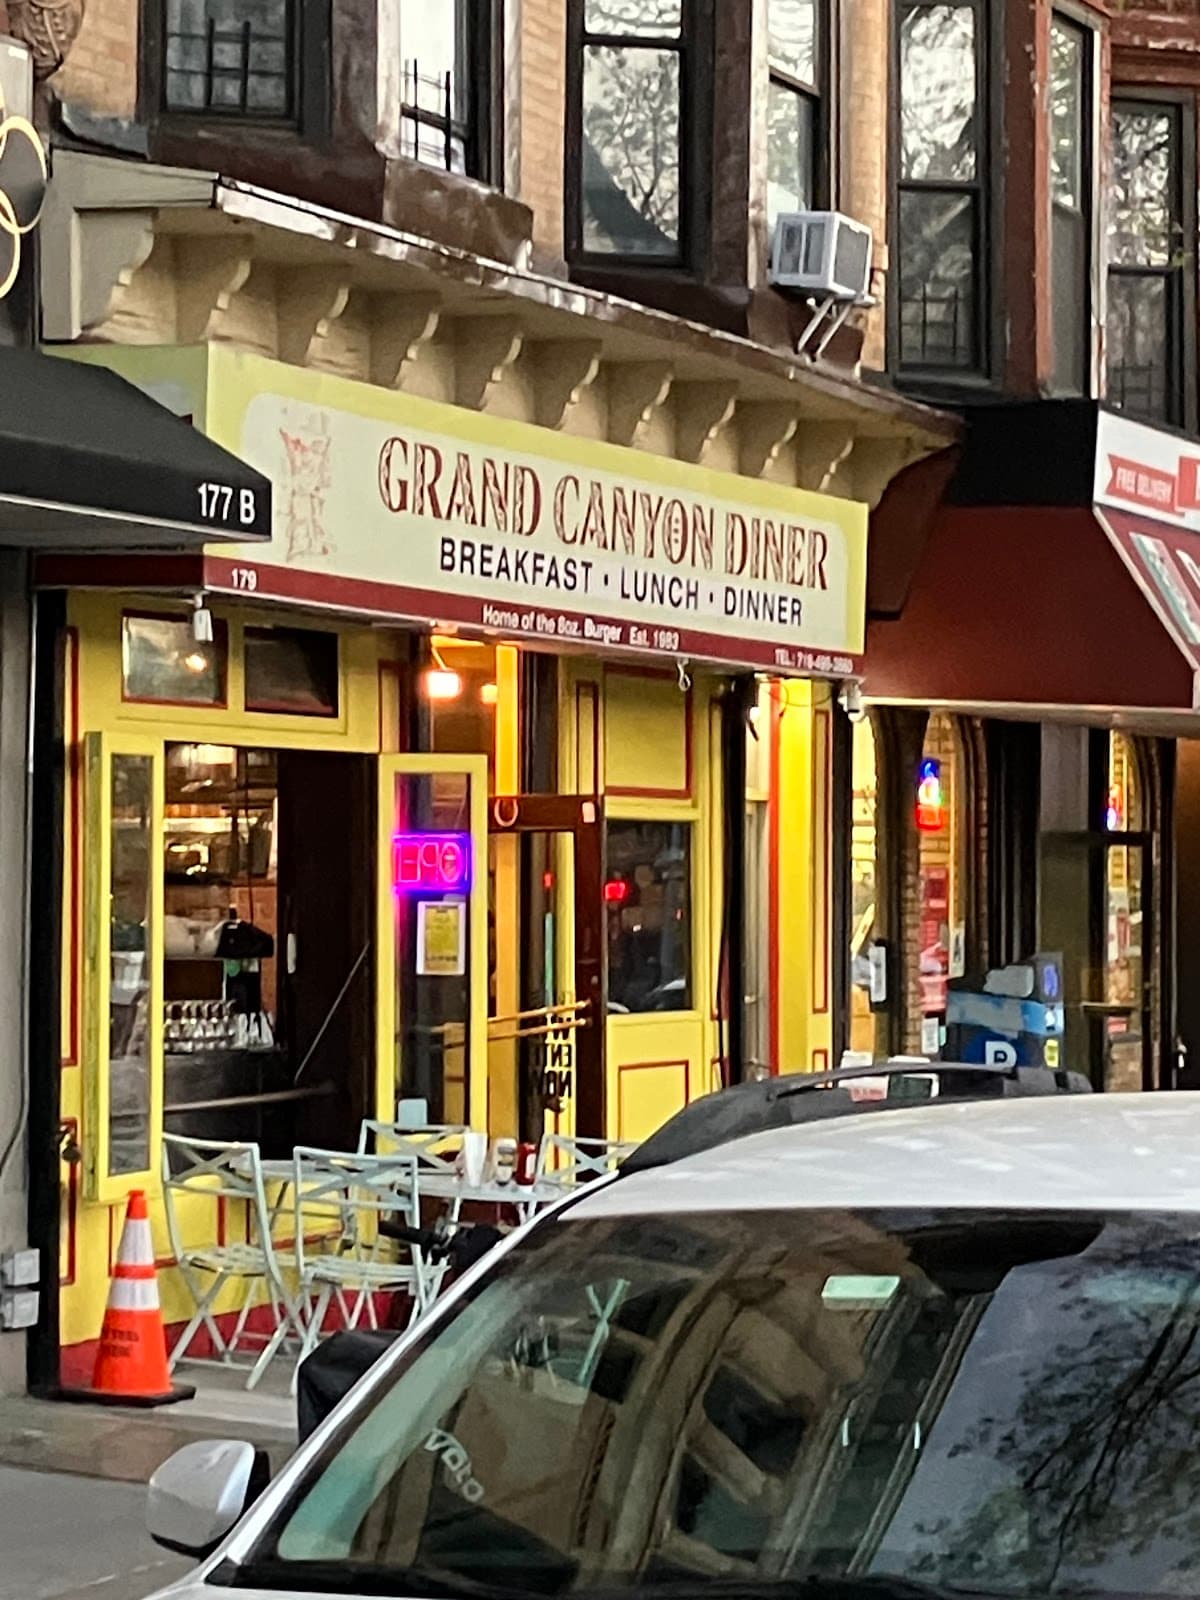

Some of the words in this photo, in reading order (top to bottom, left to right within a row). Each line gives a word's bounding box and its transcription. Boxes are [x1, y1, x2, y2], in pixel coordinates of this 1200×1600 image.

[197, 482, 233, 521] 177
[239, 488, 256, 525] B
[377, 435, 542, 537] GRAND
[553, 474, 715, 571] CANYON
[723, 510, 829, 592] DINER
[230, 567, 257, 591] 179
[439, 535, 594, 595] BREAKFAST
[619, 566, 700, 611] LUNCH
[723, 585, 803, 627] DINNER
[482, 604, 519, 628] Home
[521, 611, 535, 630] of
[535, 612, 555, 634] the
[584, 617, 623, 645] Burger
